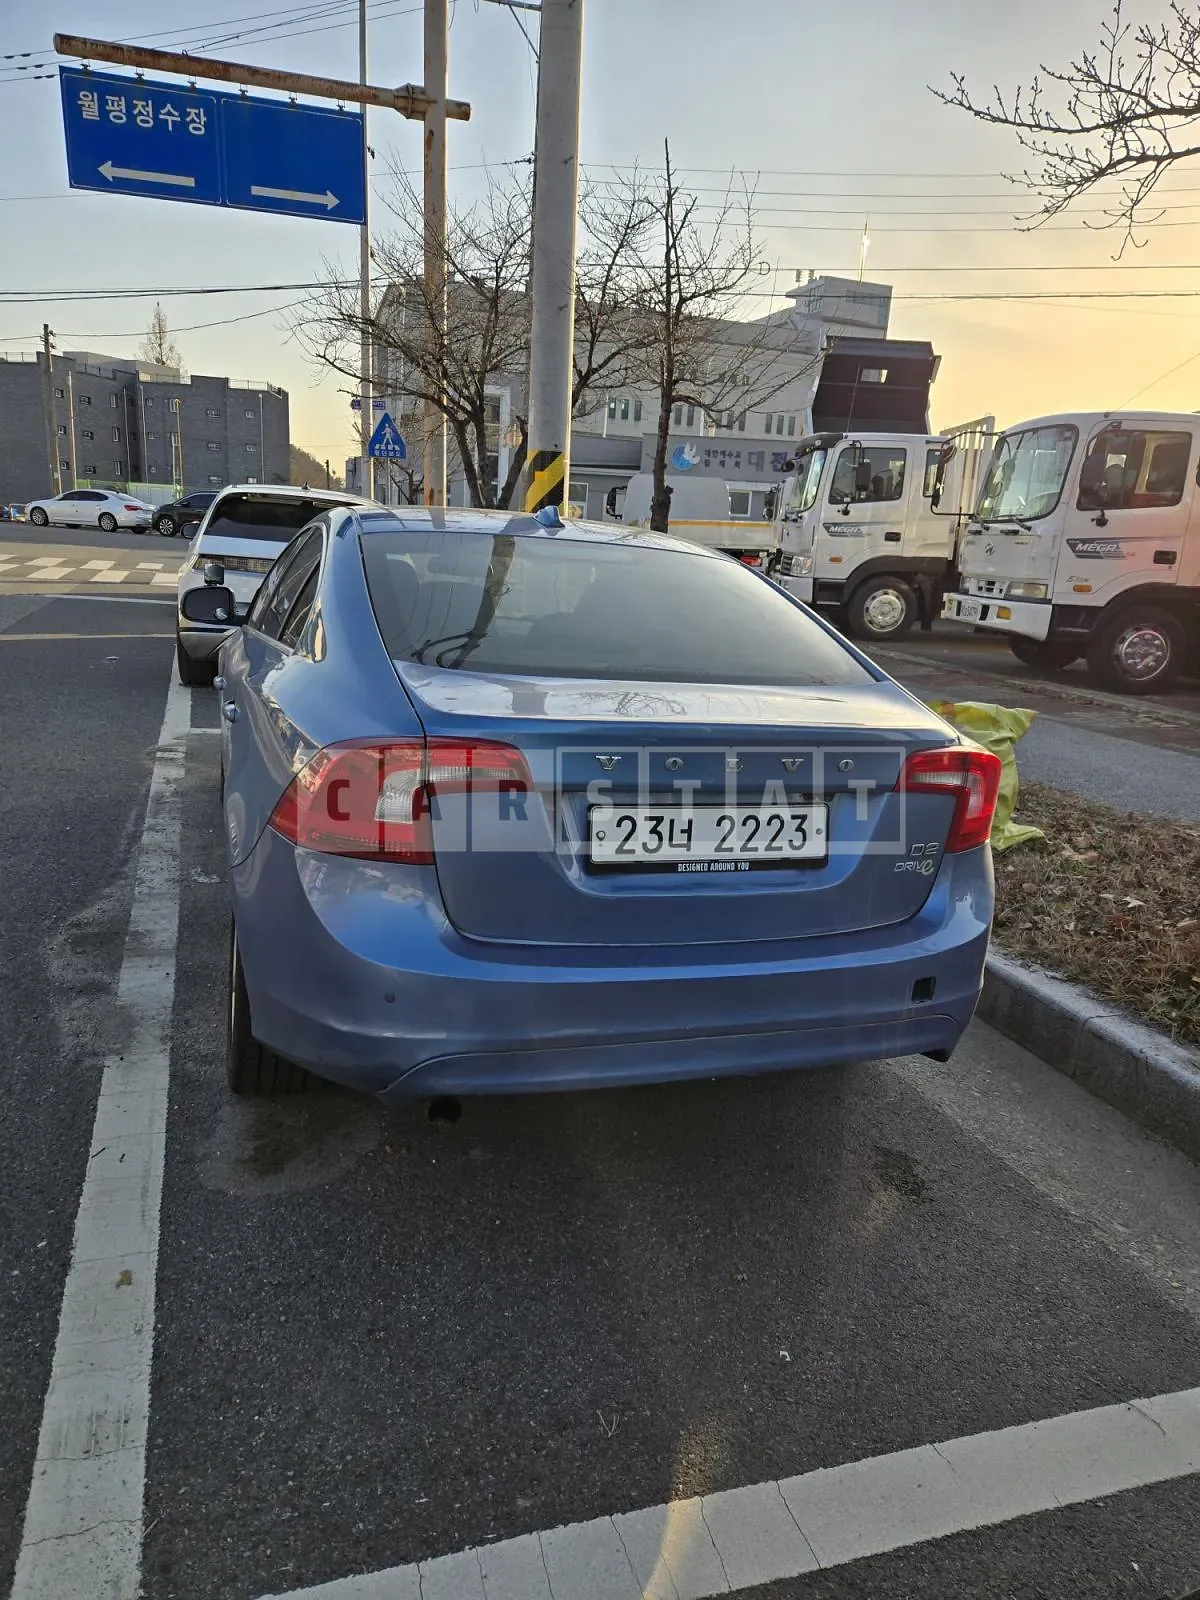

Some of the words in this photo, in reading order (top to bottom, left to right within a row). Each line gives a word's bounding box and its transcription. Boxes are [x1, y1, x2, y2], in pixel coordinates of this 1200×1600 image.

[77, 90, 207, 136] 월평정수장
[1075, 543, 1118, 552] MEGA
[595, 755, 855, 773] VOLVO
[615, 815, 693, 855] 23너
[714, 813, 808, 853] 2223
[677, 862, 708, 872] DESIGNED
[710, 861, 735, 872] AROUND
[737, 861, 749, 871] YOU
